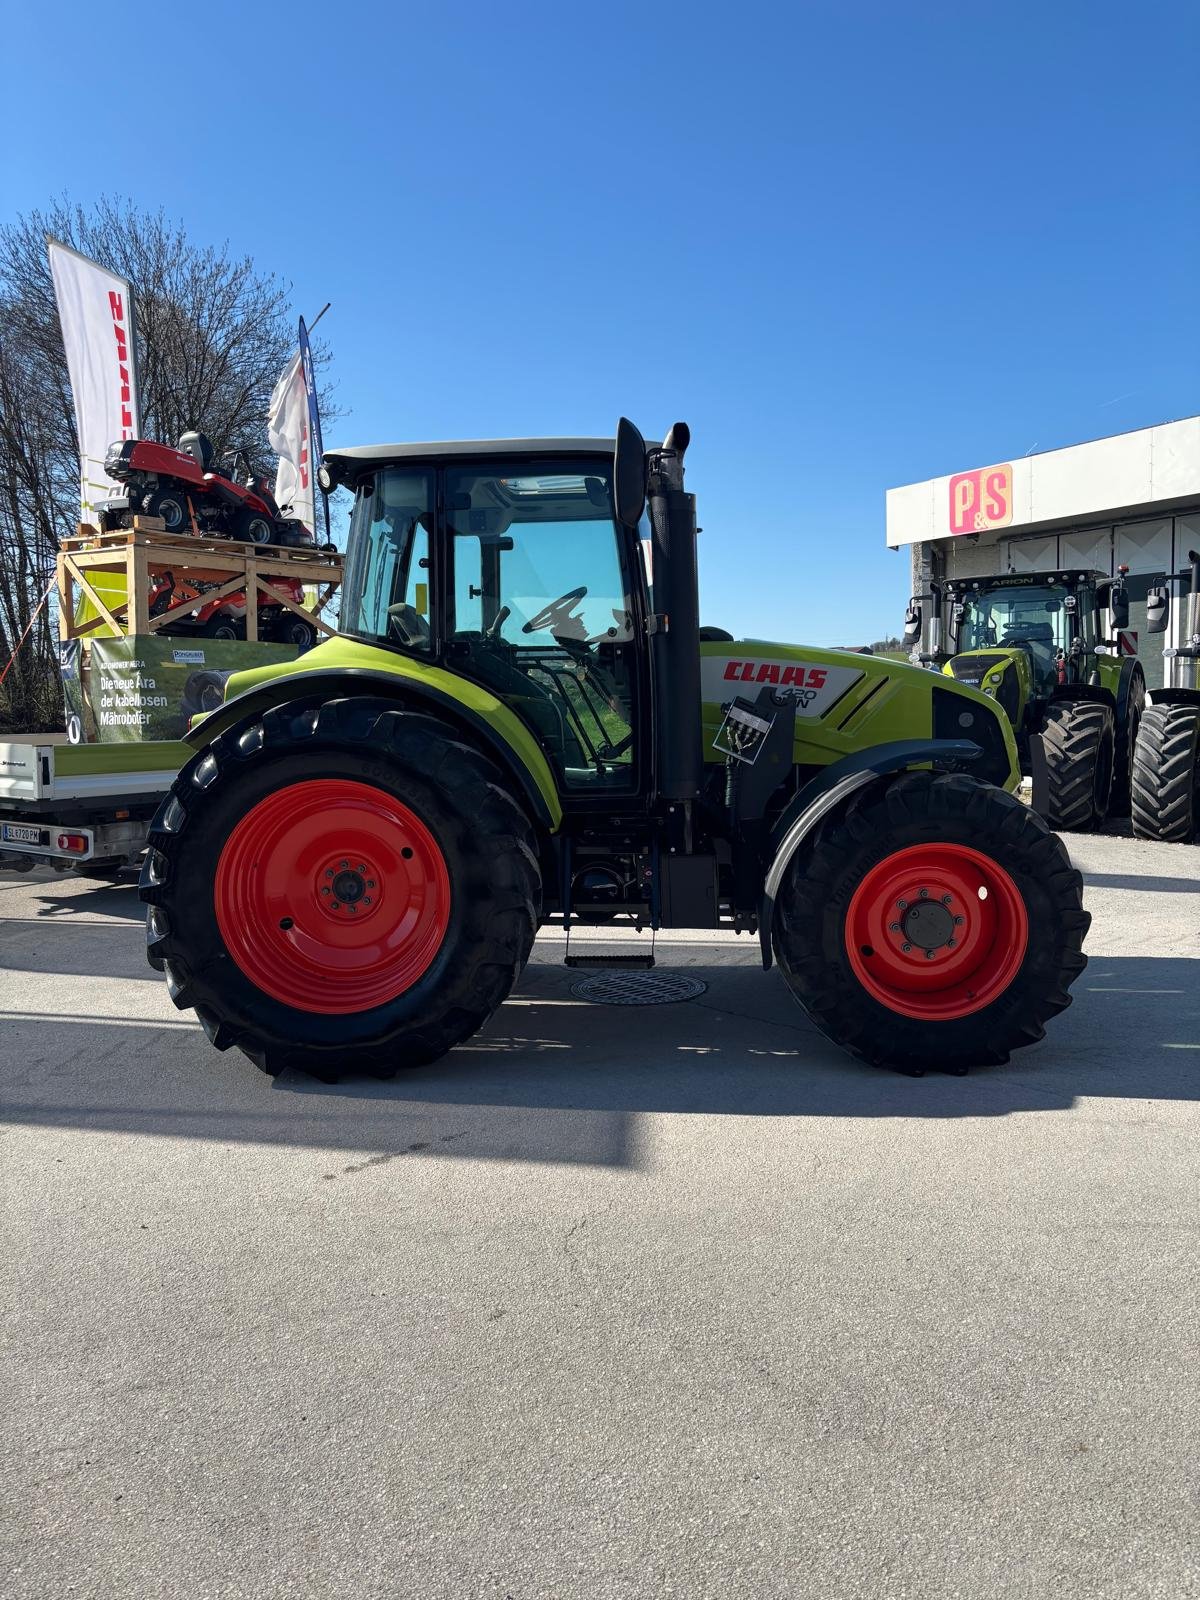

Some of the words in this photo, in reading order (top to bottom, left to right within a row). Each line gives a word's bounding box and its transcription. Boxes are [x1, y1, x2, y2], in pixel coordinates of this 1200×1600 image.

[954, 472, 1007, 530] P&S
[992, 578, 1034, 586] ARION
[723, 661, 828, 689] CLAAS
[100, 677, 114, 690] Die
[114, 679, 134, 690] neue
[101, 694, 113, 708] der
[115, 693, 168, 707] kabellosen
[781, 687, 817, 704] 420
[100, 711, 152, 726] Mähroboter
